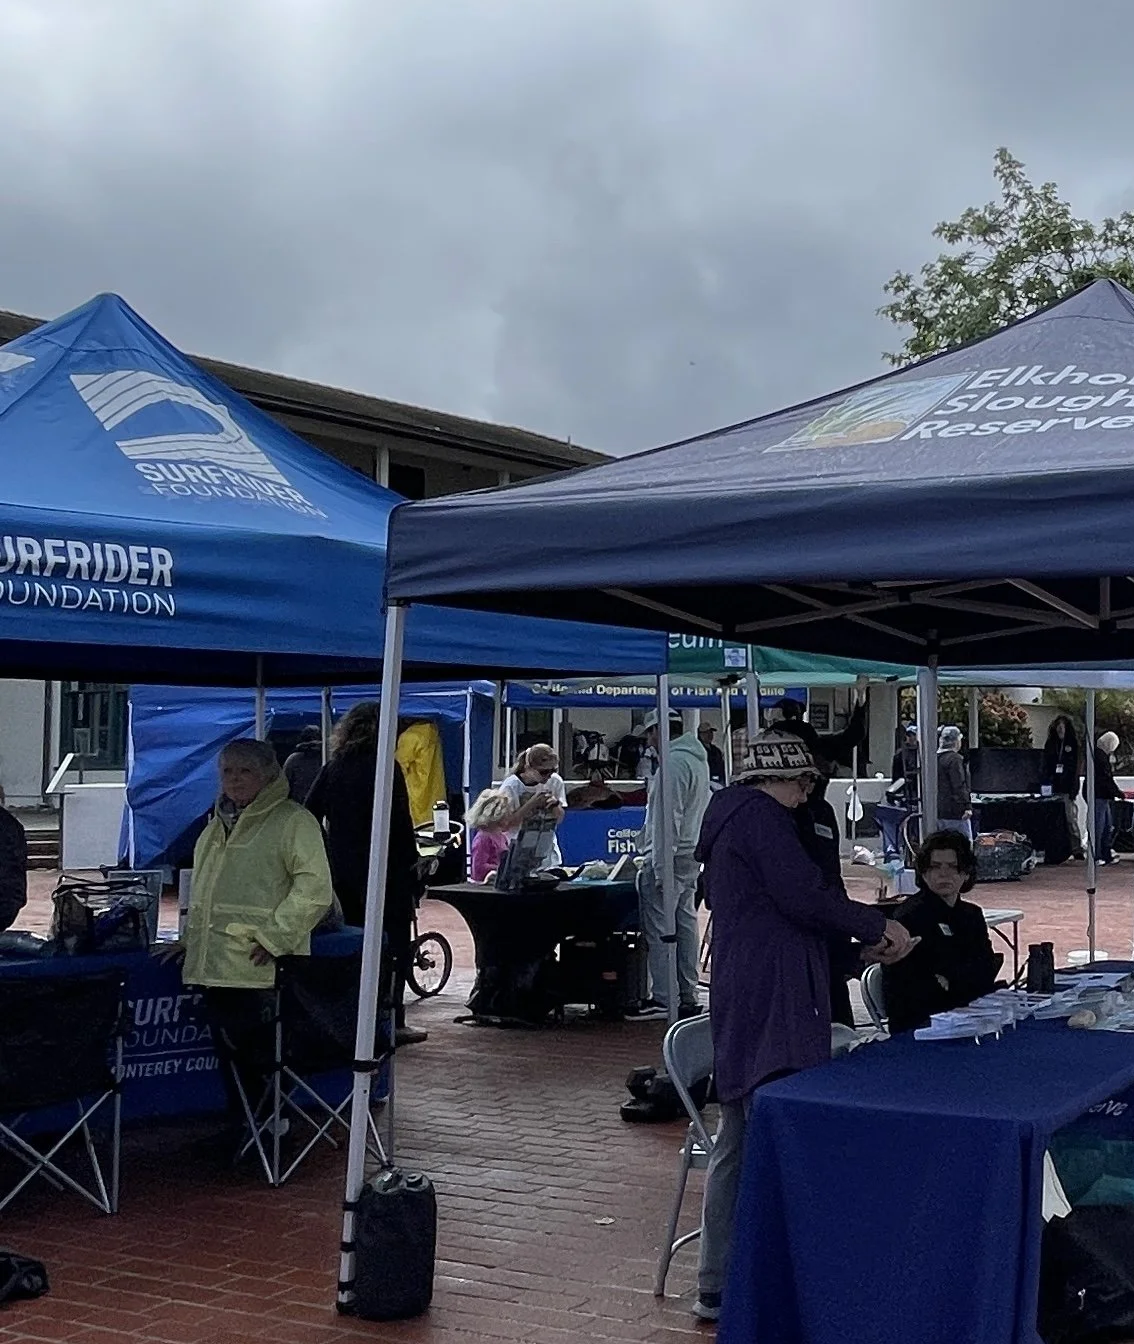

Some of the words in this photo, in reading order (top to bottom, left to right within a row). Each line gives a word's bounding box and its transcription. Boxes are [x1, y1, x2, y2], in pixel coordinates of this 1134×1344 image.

[134, 462, 313, 506] SURFRIDER
[152, 483, 328, 519] FOUNDATION
[0, 536, 173, 587] URFRIDER
[0, 580, 175, 616] UNDATION
[597, 685, 657, 696] Departme
[607, 839, 636, 854] Fish
[111, 1058, 182, 1079] ONTEREY
